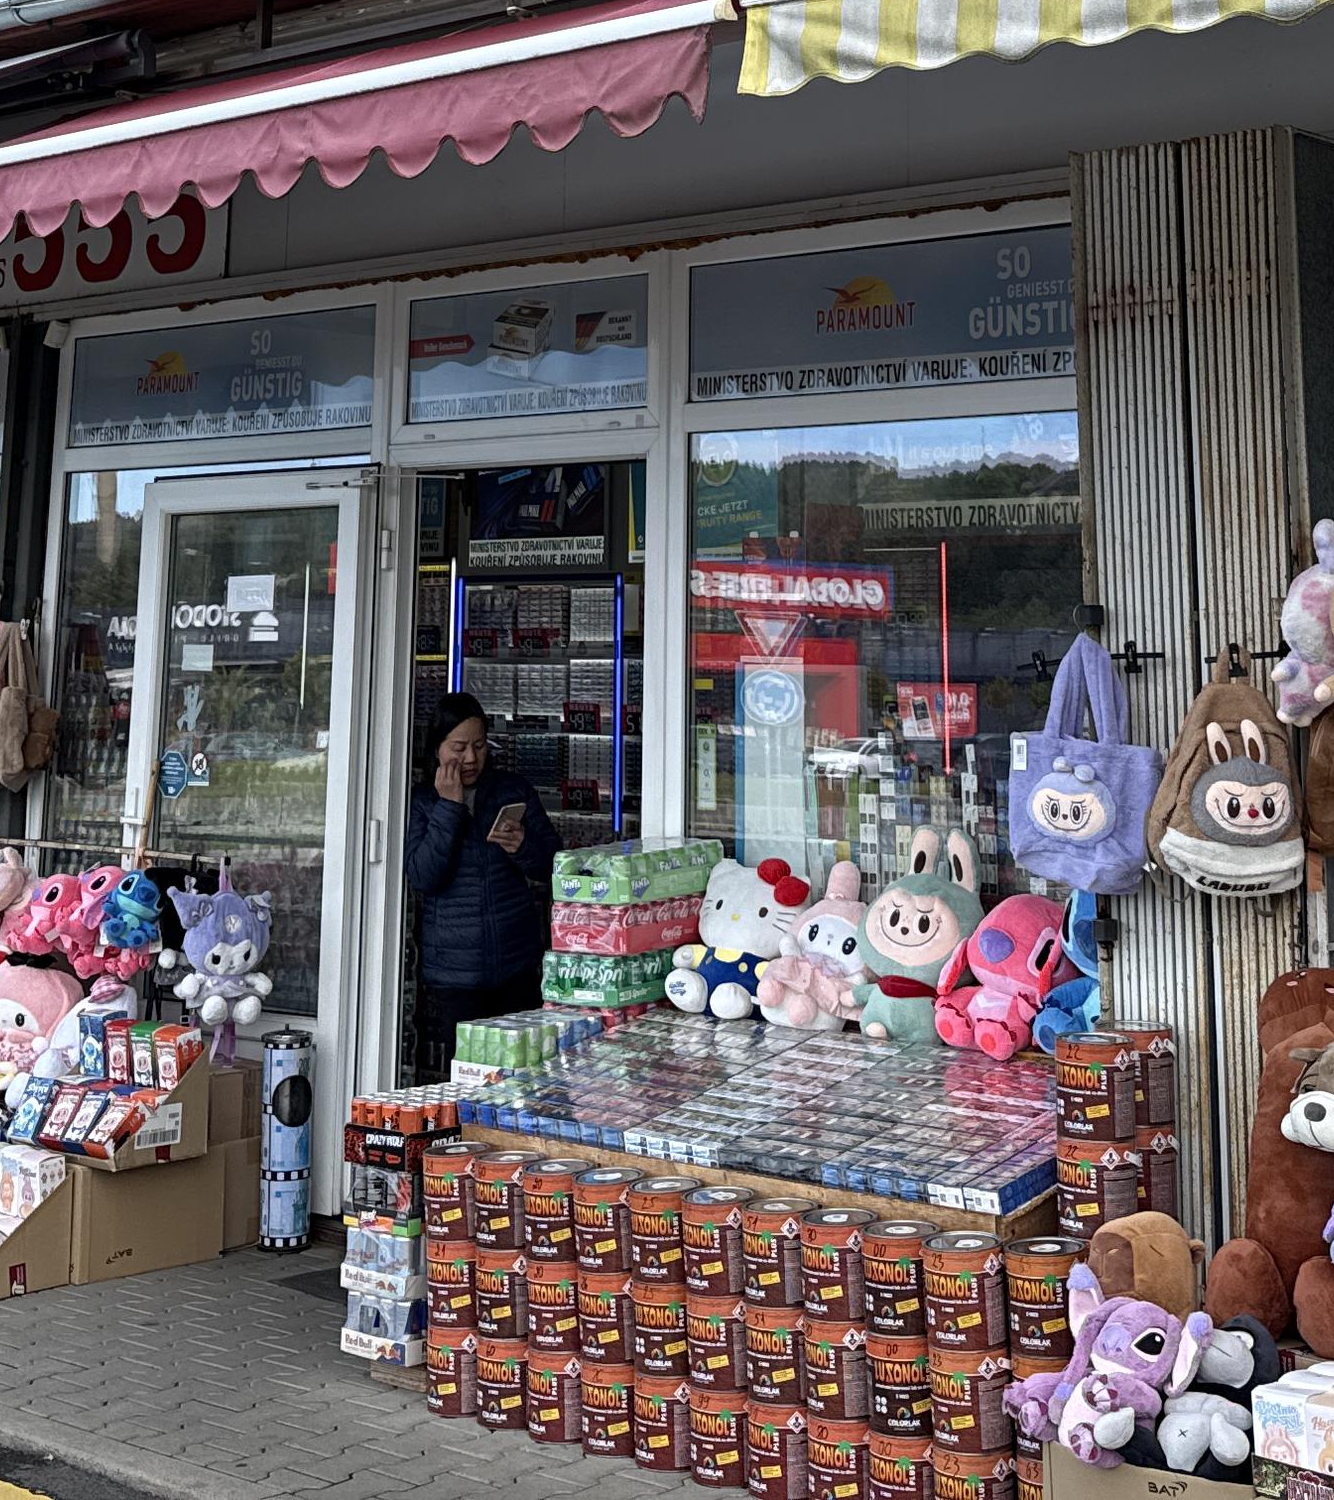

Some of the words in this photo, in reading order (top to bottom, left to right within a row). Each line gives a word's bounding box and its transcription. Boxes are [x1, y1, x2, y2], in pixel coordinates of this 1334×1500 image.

[12, 190, 206, 292] 555
[995, 246, 1032, 281] SO
[1007, 280, 1065, 301] GENIESST
[816, 302, 916, 334] PARAMOUNT
[251, 330, 272, 356] SO
[697, 374, 795, 398] MINISTERSTVO
[799, 357, 908, 391] ZDRAVOTNICTVÍ
[978, 348, 1049, 378] KOUŘENÍ
[136, 372, 200, 397] PARAMOUNT
[230, 369, 302, 402] GÜNSTIG
[325, 404, 371, 426] RAKOVINU
[469, 552, 507, 567] KOUŘENÍ
[559, 551, 605, 565] RAKOVINU
[1100, 1069, 1108, 1090] PLUS
[1056, 1281, 1064, 1303] PLUS
[873, 1316, 905, 1328] COLORLAK
[935, 1331, 967, 1342] COLORLAK
[1019, 1336, 1052, 1348] COLORLAK
[887, 1417, 921, 1428] COLORLAK
[1148, 1482, 1180, 1497] BAT
